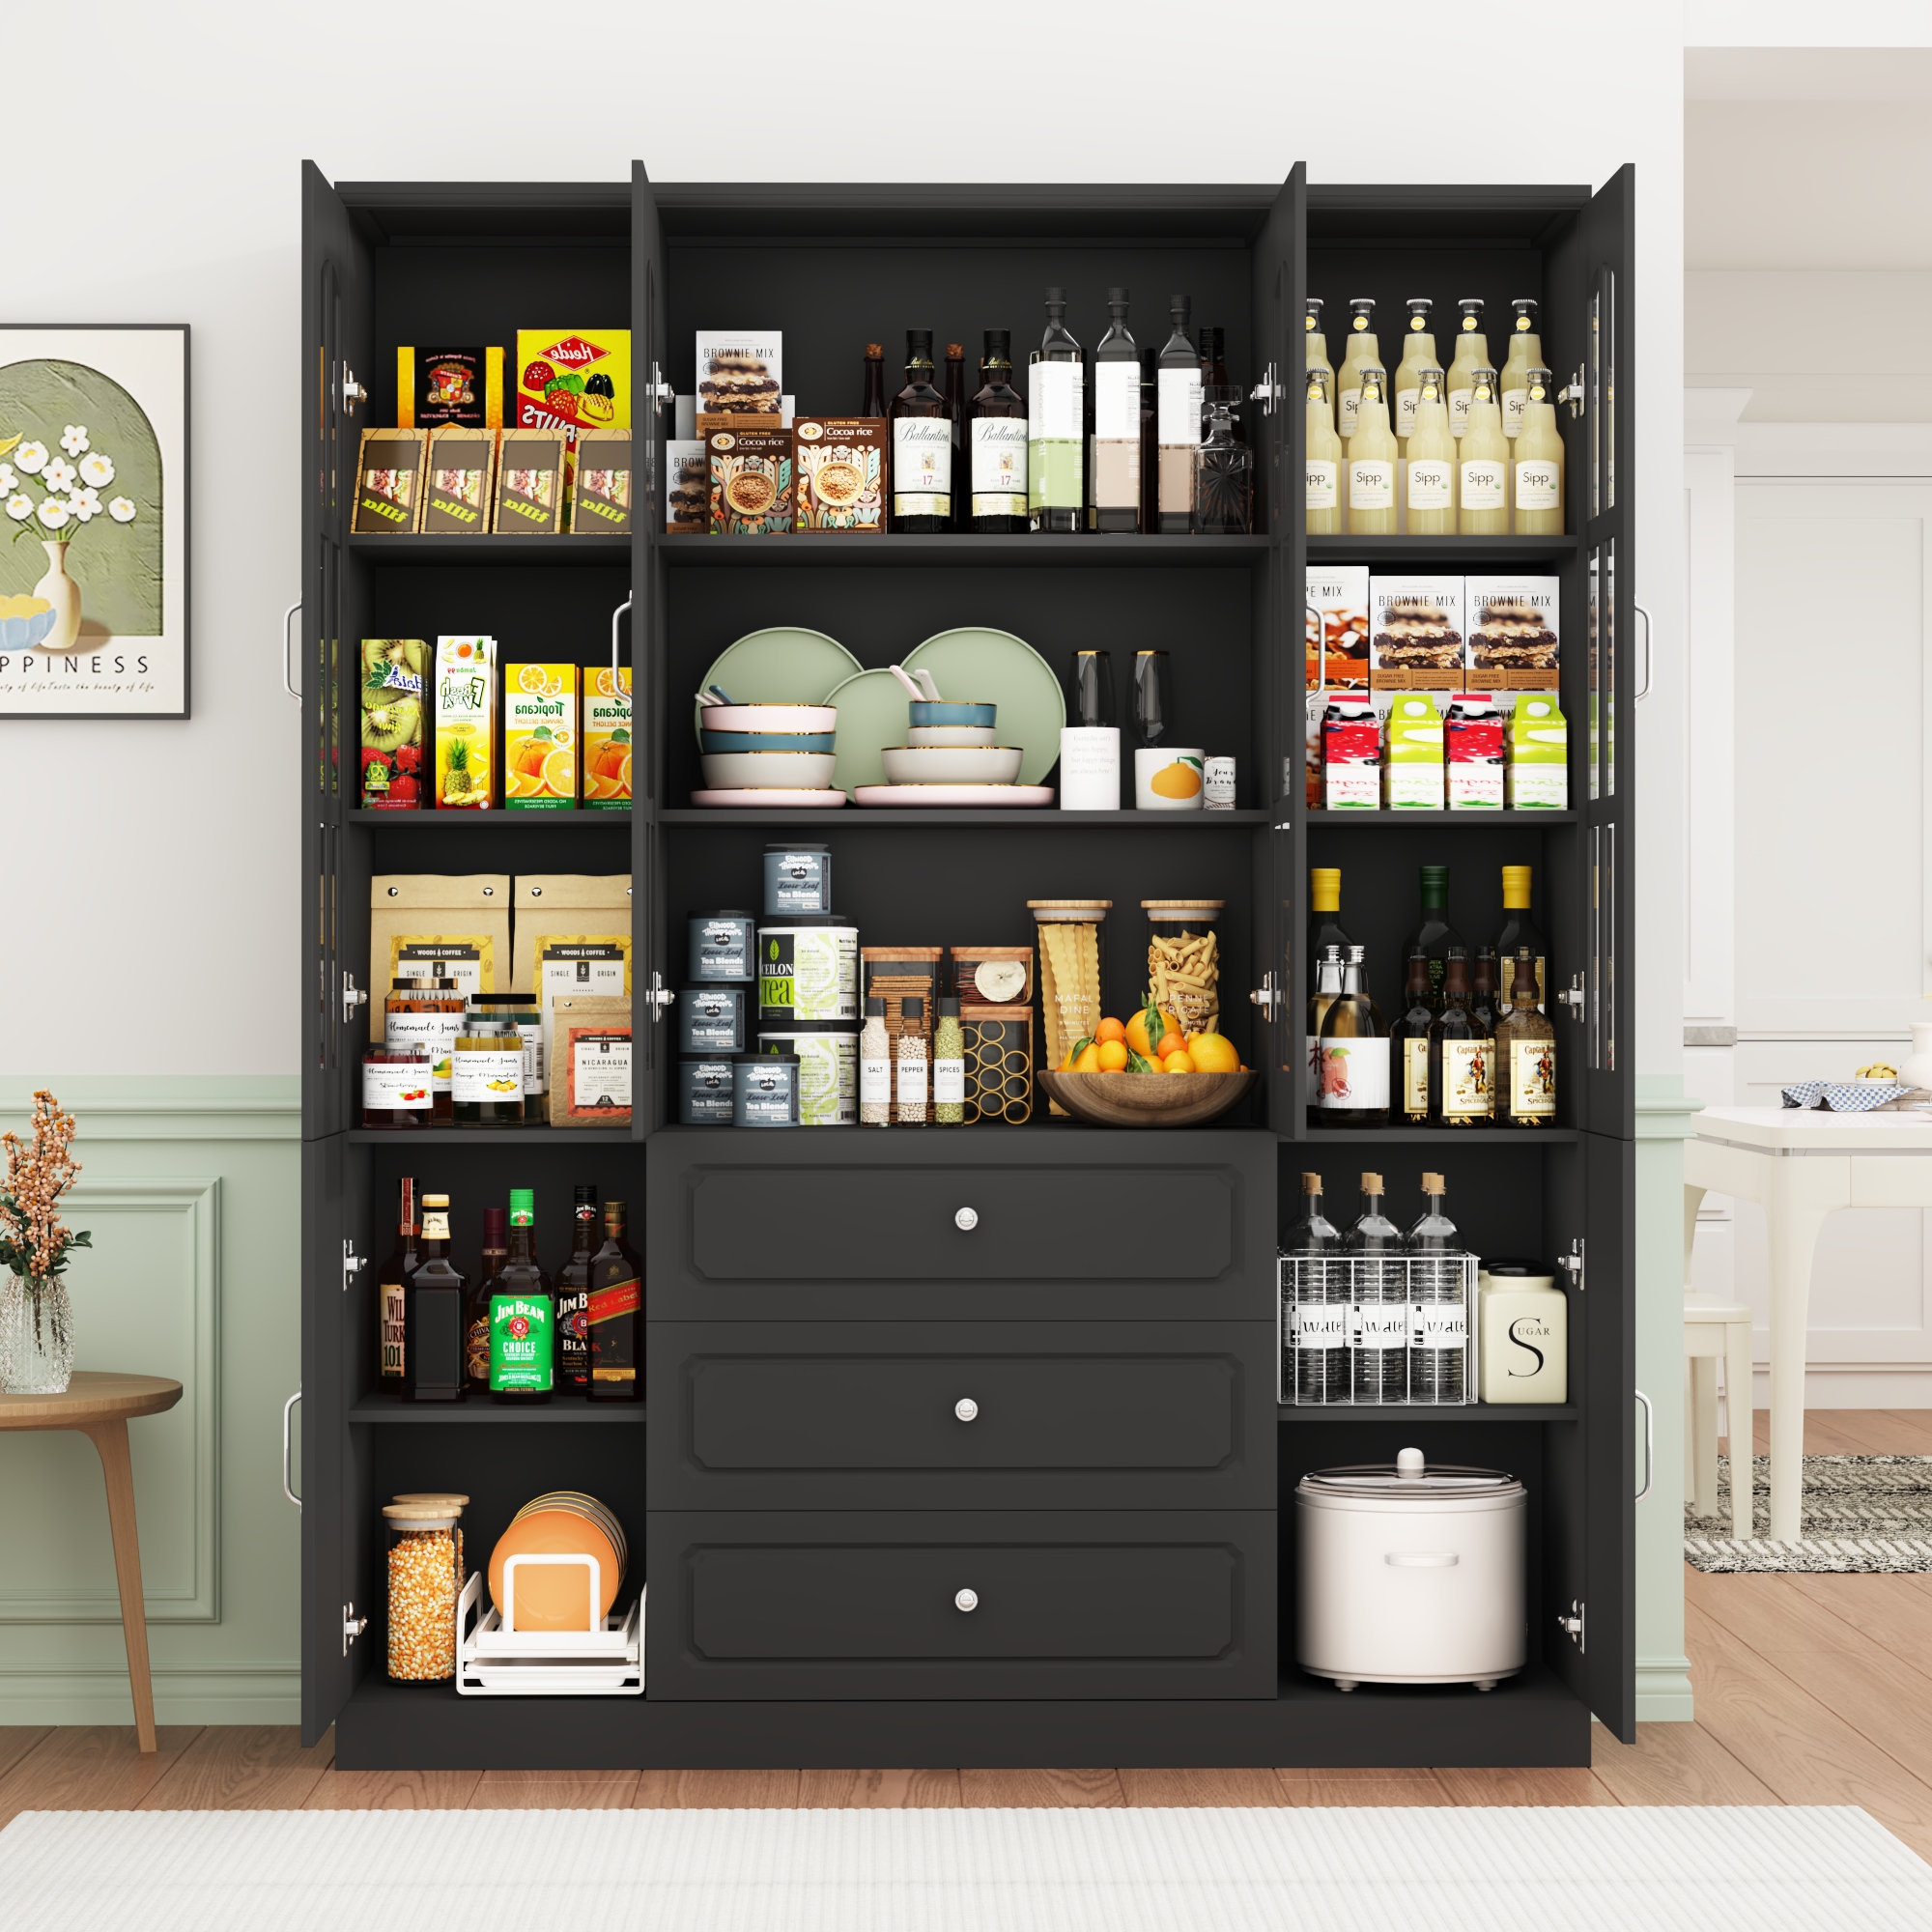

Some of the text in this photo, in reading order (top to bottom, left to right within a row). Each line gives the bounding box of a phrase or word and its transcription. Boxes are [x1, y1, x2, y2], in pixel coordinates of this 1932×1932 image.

[704, 348, 774, 357] BROWNIE MIX
[923, 475, 933, 485] 17
[1001, 475, 1011, 485] 17
[1356, 471, 1382, 486] Sipp
[1415, 471, 1440, 486] Sipp
[1468, 471, 1494, 486] Sipp
[1522, 471, 1549, 486] Sipp
[1323, 586, 1343, 597] MIX
[1378, 595, 1456, 607] BROWNIE MIX
[1474, 595, 1550, 607] BROWNIE MIX
[761, 963, 793, 976] CEILON
[1060, 1006, 1089, 1014] DINE
[388, 1021, 436, 1032] Homemade
[1457, 1045, 1477, 1056] Captain
[1524, 1045, 1545, 1056] Captain
[511, 1210, 520, 1219] JIM
[557, 1296, 578, 1320] JIM
[588, 1292, 639, 1313] Red Label
[495, 1300, 545, 1323] JIM BEAM
[502, 1342, 536, 1352] CHOICE
[384, 1345, 402, 1367] 101
